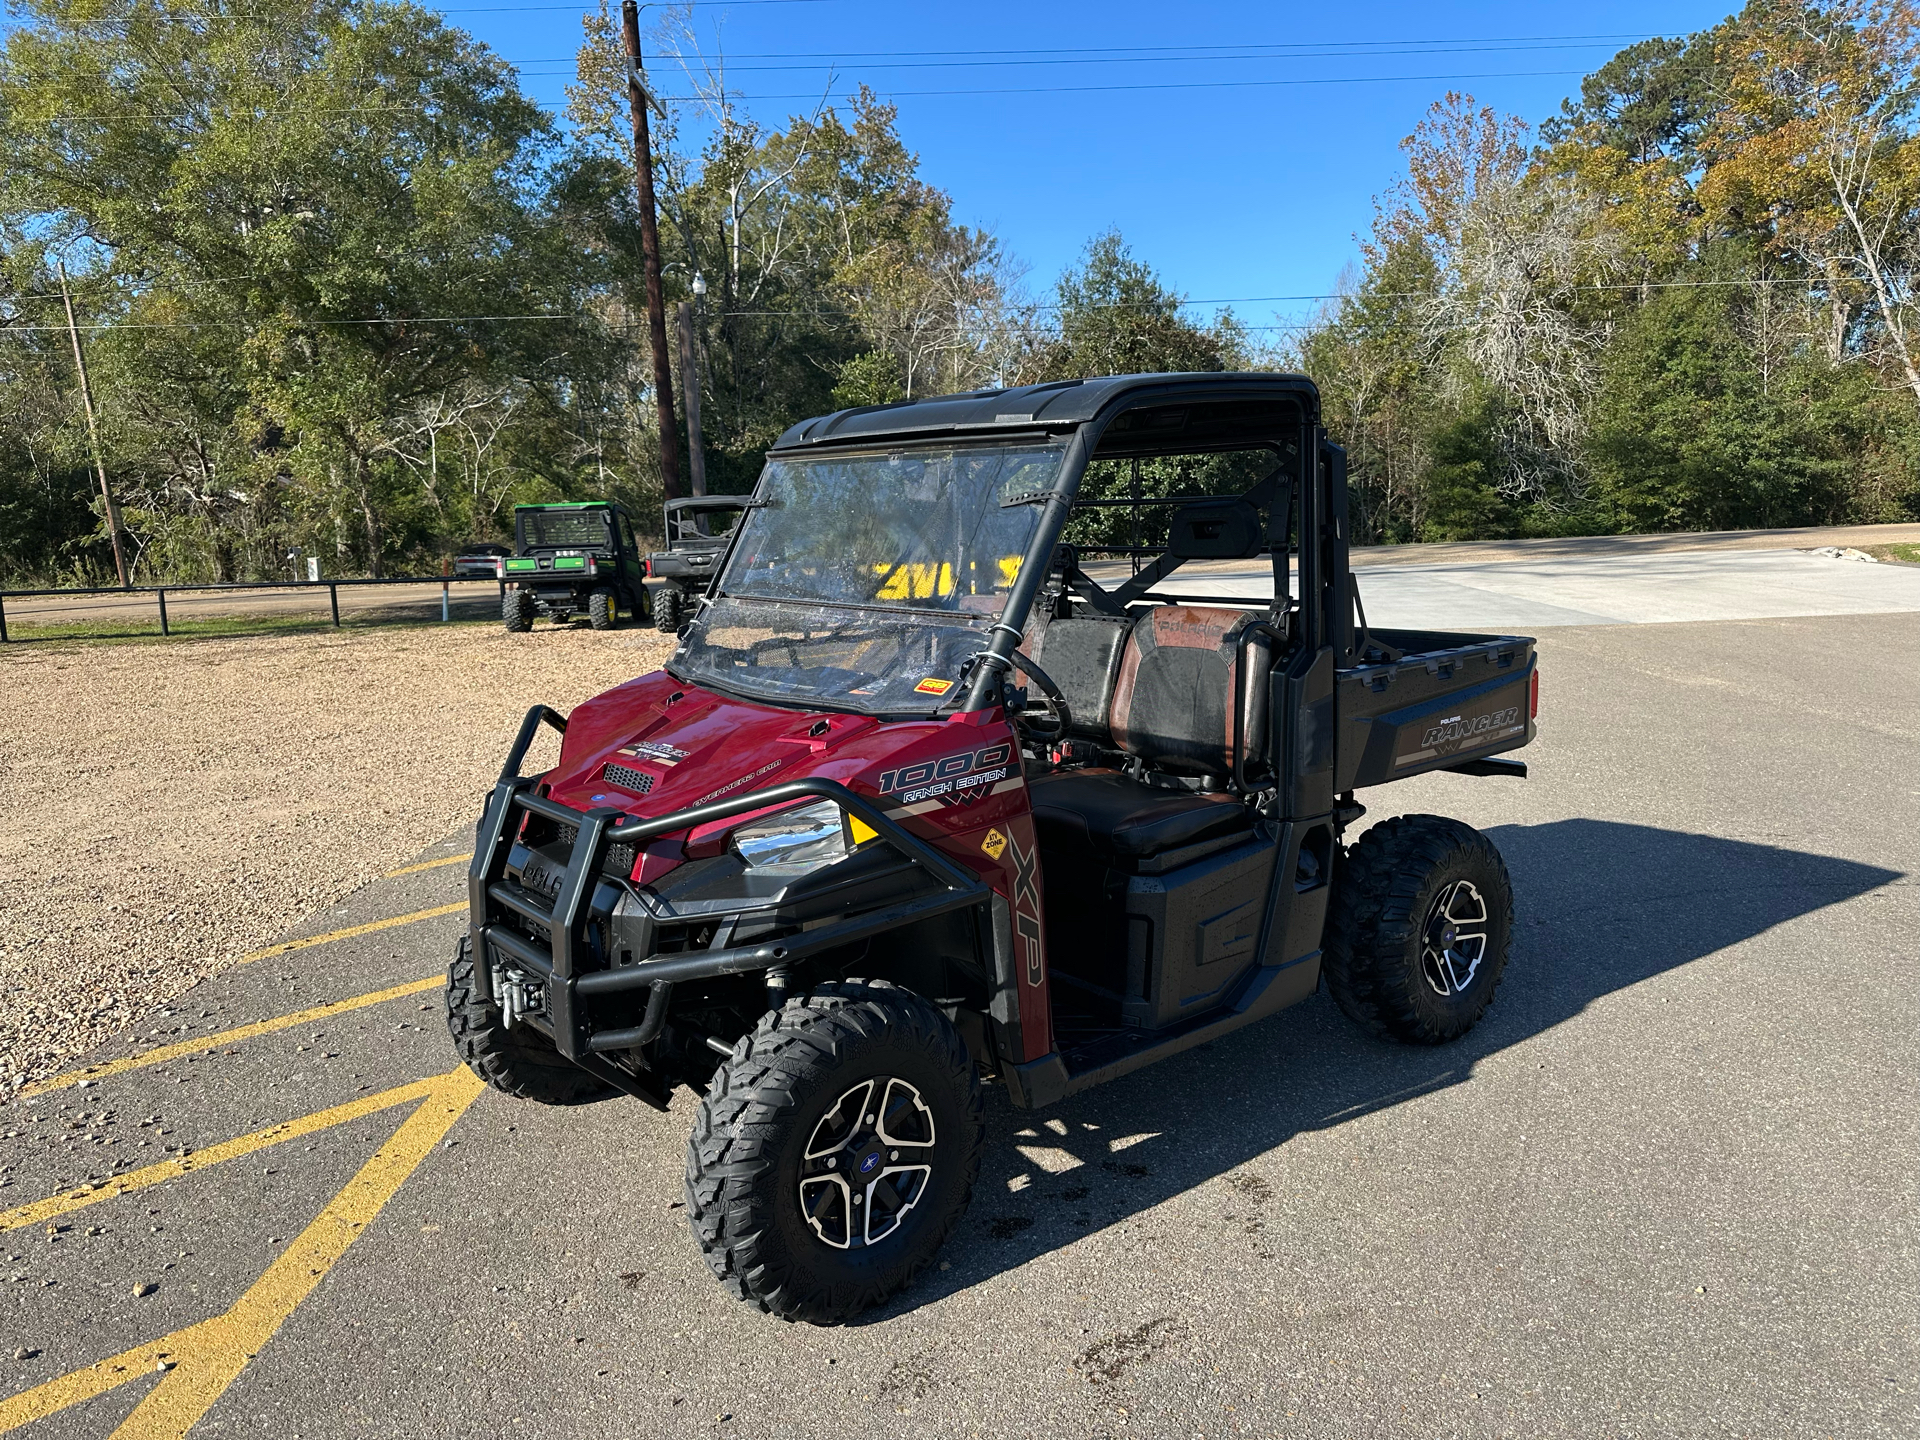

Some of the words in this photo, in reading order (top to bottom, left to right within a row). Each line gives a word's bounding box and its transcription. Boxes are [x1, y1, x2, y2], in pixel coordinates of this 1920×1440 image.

[1159, 620, 1223, 637] POLARIS
[1421, 707, 1519, 748] RANGER
[1440, 716, 1461, 725] POLARIS
[692, 773, 755, 808] OVERHEAD
[756, 759, 782, 776] CAM
[879, 743, 1012, 795] 1000
[903, 781, 952, 803] RANCH
[956, 768, 1007, 790] EDITION
[985, 838, 1004, 849] ZONE
[989, 832, 998, 841] ATV
[1006, 822, 1044, 988] XP
